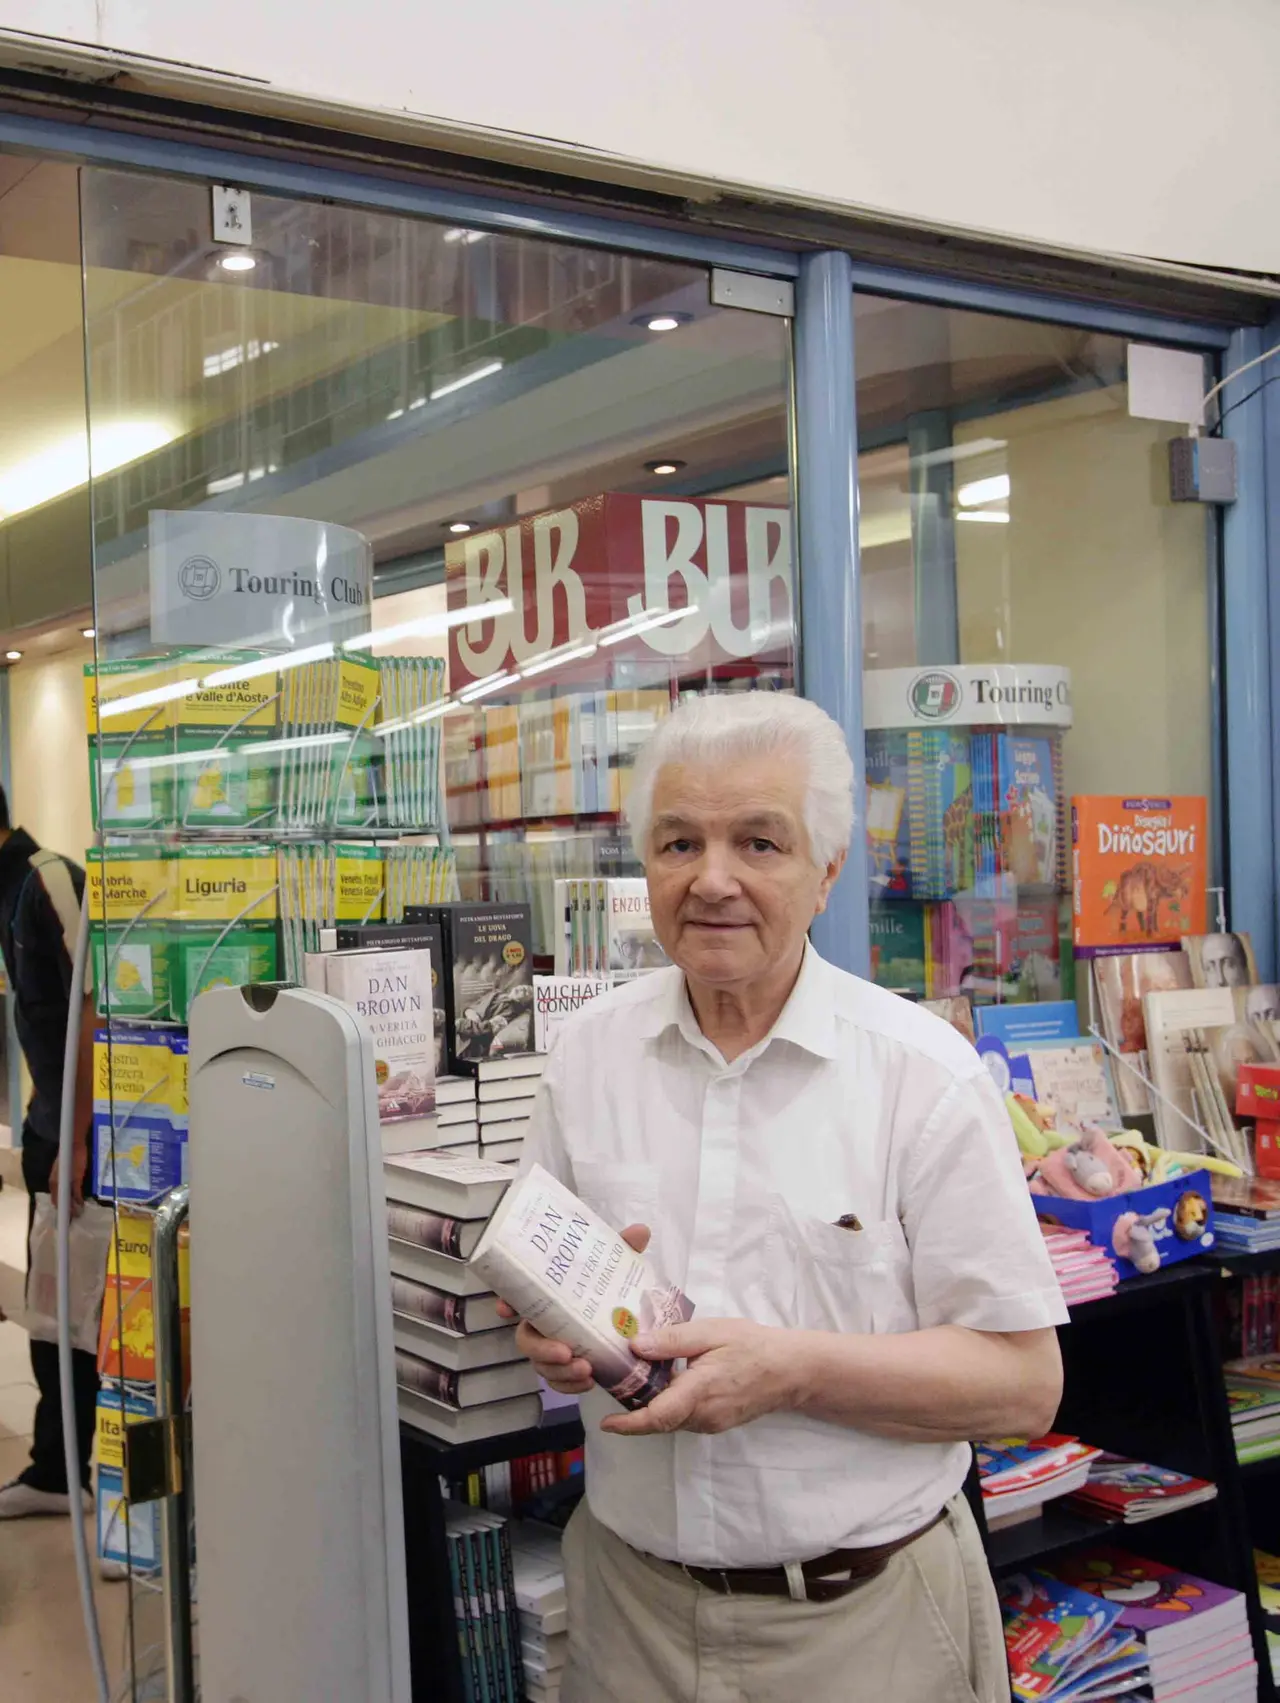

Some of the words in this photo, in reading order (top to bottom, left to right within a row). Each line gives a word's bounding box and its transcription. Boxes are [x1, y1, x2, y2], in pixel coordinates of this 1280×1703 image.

[228, 567, 325, 605] Touring
[331, 576, 363, 606] Club
[627, 499, 792, 658] BUR
[455, 508, 599, 677] BUR
[196, 691, 224, 702] Valle
[226, 691, 269, 704] d'Aosta
[970, 678, 1053, 712] Touring
[1096, 821, 1196, 857] Dinosauri
[91, 875, 133, 888] Umbria
[185, 878, 247, 897] Liguria
[92, 890, 100, 900] e
[104, 888, 148, 900] Marche
[612, 896, 641, 914] ENZO
[478, 924, 487, 933] LE
[488, 923, 507, 932] UOVA
[474, 935, 487, 944] DEL
[488, 933, 512, 943] DRAGO
[367, 975, 409, 995] DAN
[355, 994, 422, 1017] BROWN
[376, 1033, 427, 1049] GHIACCIO
[99, 1051, 140, 1066] Astria
[99, 1066, 145, 1080] Sizzera
[99, 1079, 146, 1094] Slvenia
[529, 1204, 564, 1256] DAN
[544, 1211, 591, 1287] BROWN
[571, 1280, 588, 1299] LA
[581, 1297, 601, 1322] DEL
[594, 1242, 626, 1297] GHIACCIO
[100, 1416, 121, 1437] Ita
